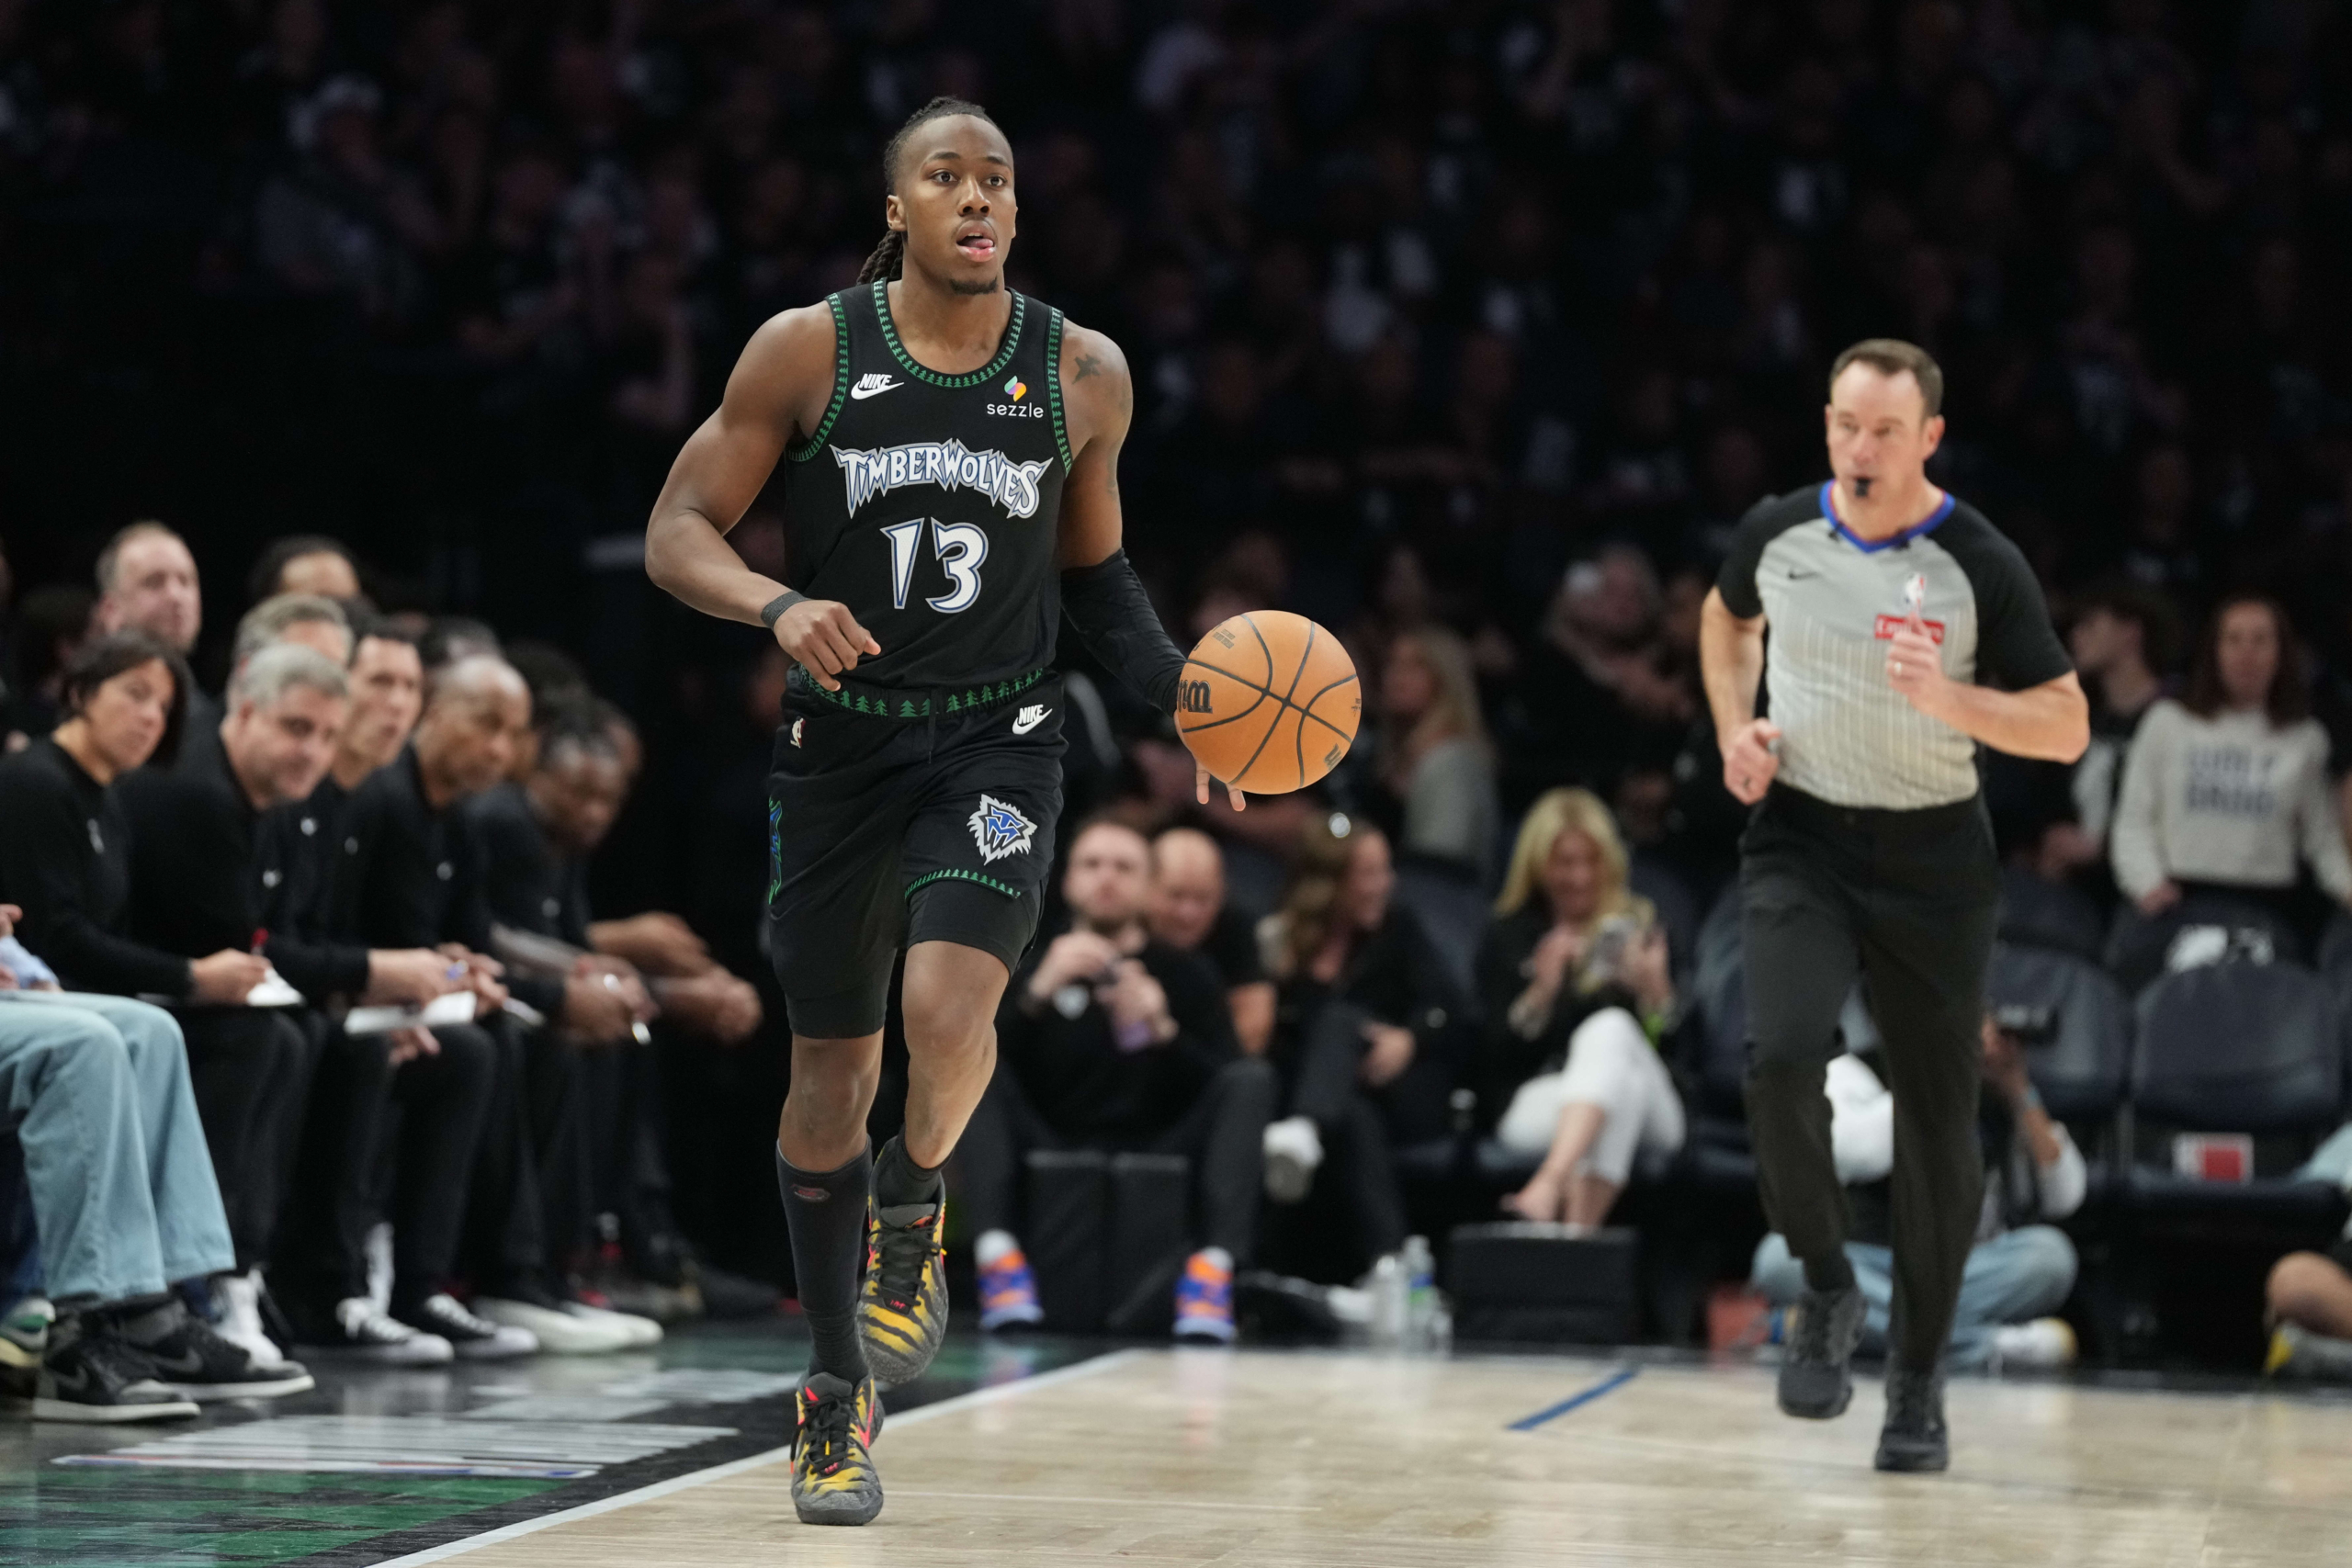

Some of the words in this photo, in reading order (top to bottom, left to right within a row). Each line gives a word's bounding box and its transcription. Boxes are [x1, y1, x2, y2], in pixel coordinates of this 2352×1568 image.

[858, 372, 893, 389] NIKE
[986, 401, 1045, 419] sezzle
[879, 516, 989, 614] 13
[1018, 704, 1044, 725] NIKE
